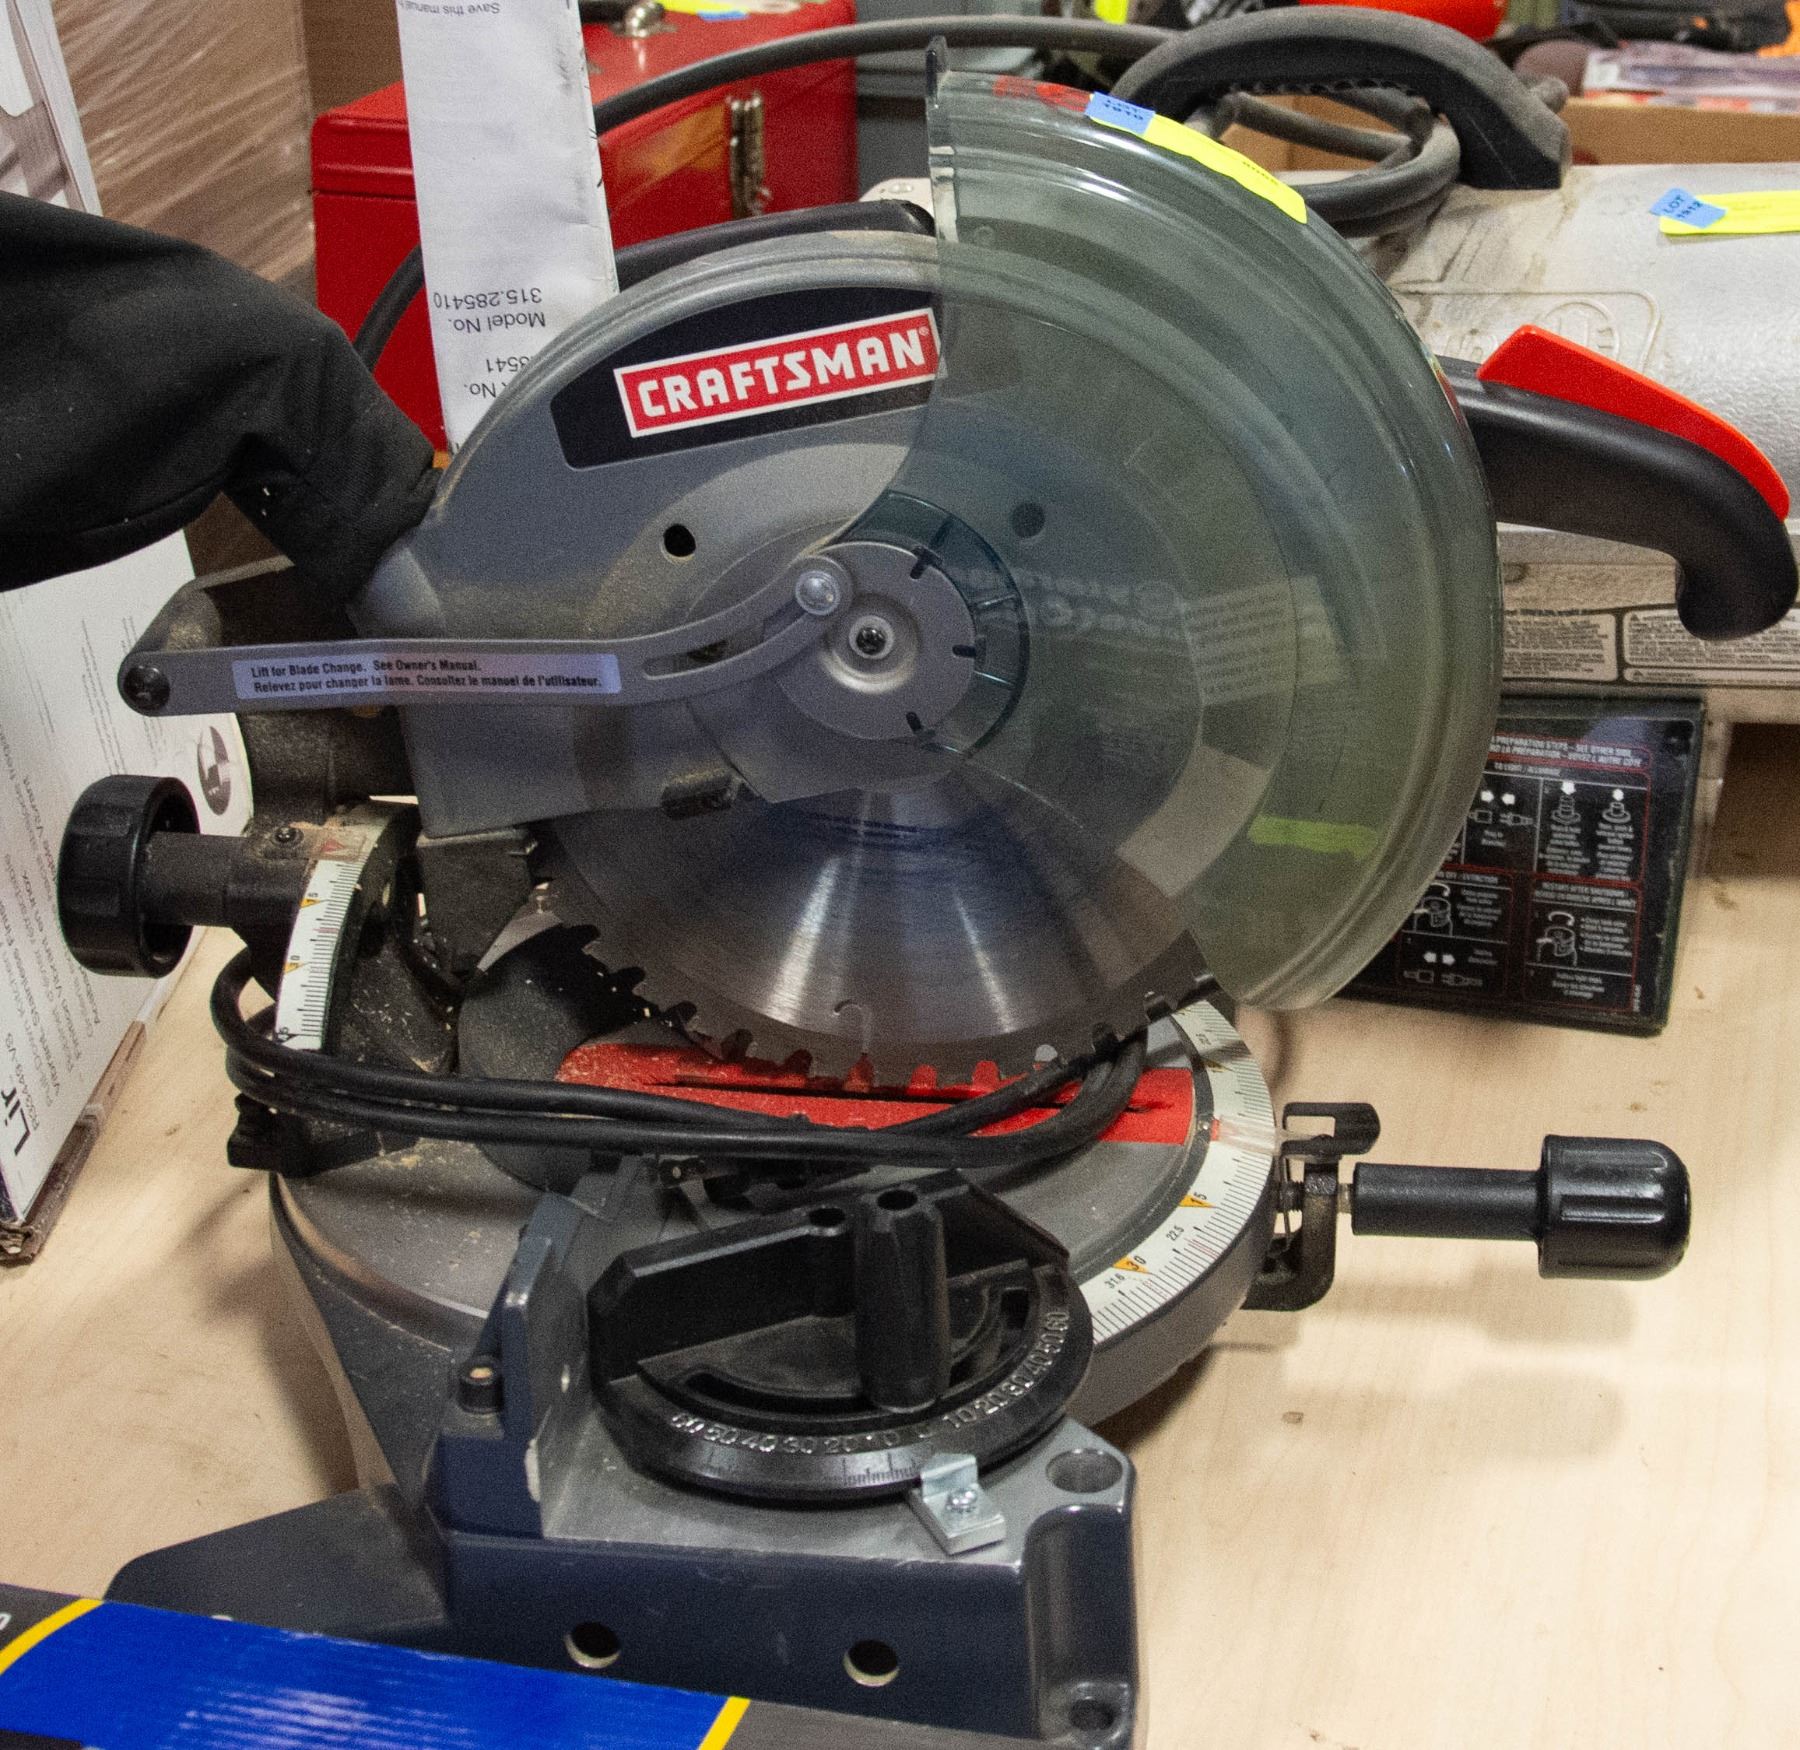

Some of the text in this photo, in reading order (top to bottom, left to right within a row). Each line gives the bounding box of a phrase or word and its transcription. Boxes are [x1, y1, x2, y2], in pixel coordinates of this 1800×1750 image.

[443, 4, 464, 16] this
[468, 2, 500, 14] Save
[1663, 195, 1684, 213] LOT
[433, 287, 542, 310] 315.285410
[448, 312, 546, 333] Model No.
[464, 382, 497, 399] No.
[251, 659, 481, 678] Lift for Blade Change. See Owner's Manual.
[254, 681, 296, 693] Relevez
[299, 681, 322, 692] pour
[326, 678, 368, 689] changer
[372, 675, 382, 686] la
[468, 675, 479, 686] le
[481, 675, 520, 686] manuel
[522, 675, 535, 686] de
[23, 775, 43, 838] Vibrant
[0, 904, 14, 946] Finis
[22, 870, 82, 1060] Finition Vibrant en inox
[1190, 1192, 1208, 1205] 15
[1126, 1255, 1147, 1271] 30
[742, 1434, 778, 1453] 40
[783, 1436, 818, 1454] 30
[823, 1437, 859, 1454] 20
[943, 1407, 978, 1429] 10
[974, 1393, 1009, 1415] 20
[1024, 1353, 1053, 1375] 40
[1046, 1311, 1071, 1332] 60
